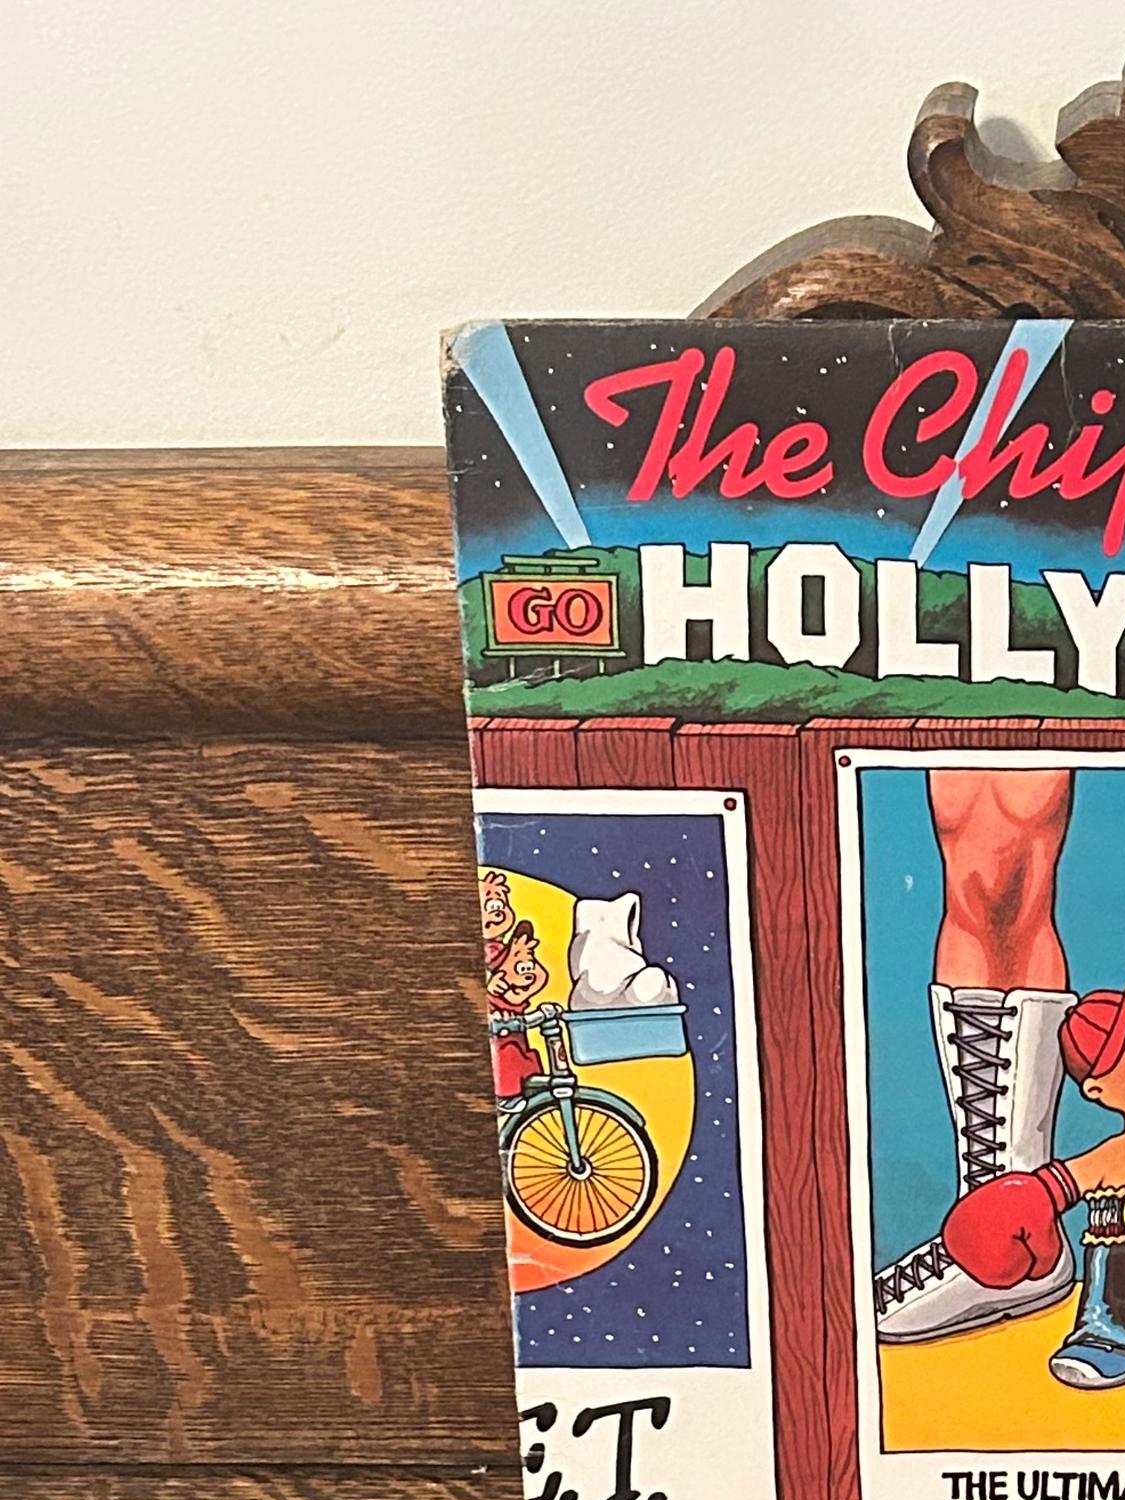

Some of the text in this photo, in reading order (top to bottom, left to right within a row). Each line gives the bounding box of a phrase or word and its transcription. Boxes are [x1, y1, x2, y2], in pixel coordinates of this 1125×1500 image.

[587, 345, 835, 503] The
[505, 583, 602, 638] GO
[941, 1471, 1008, 1500] THE
